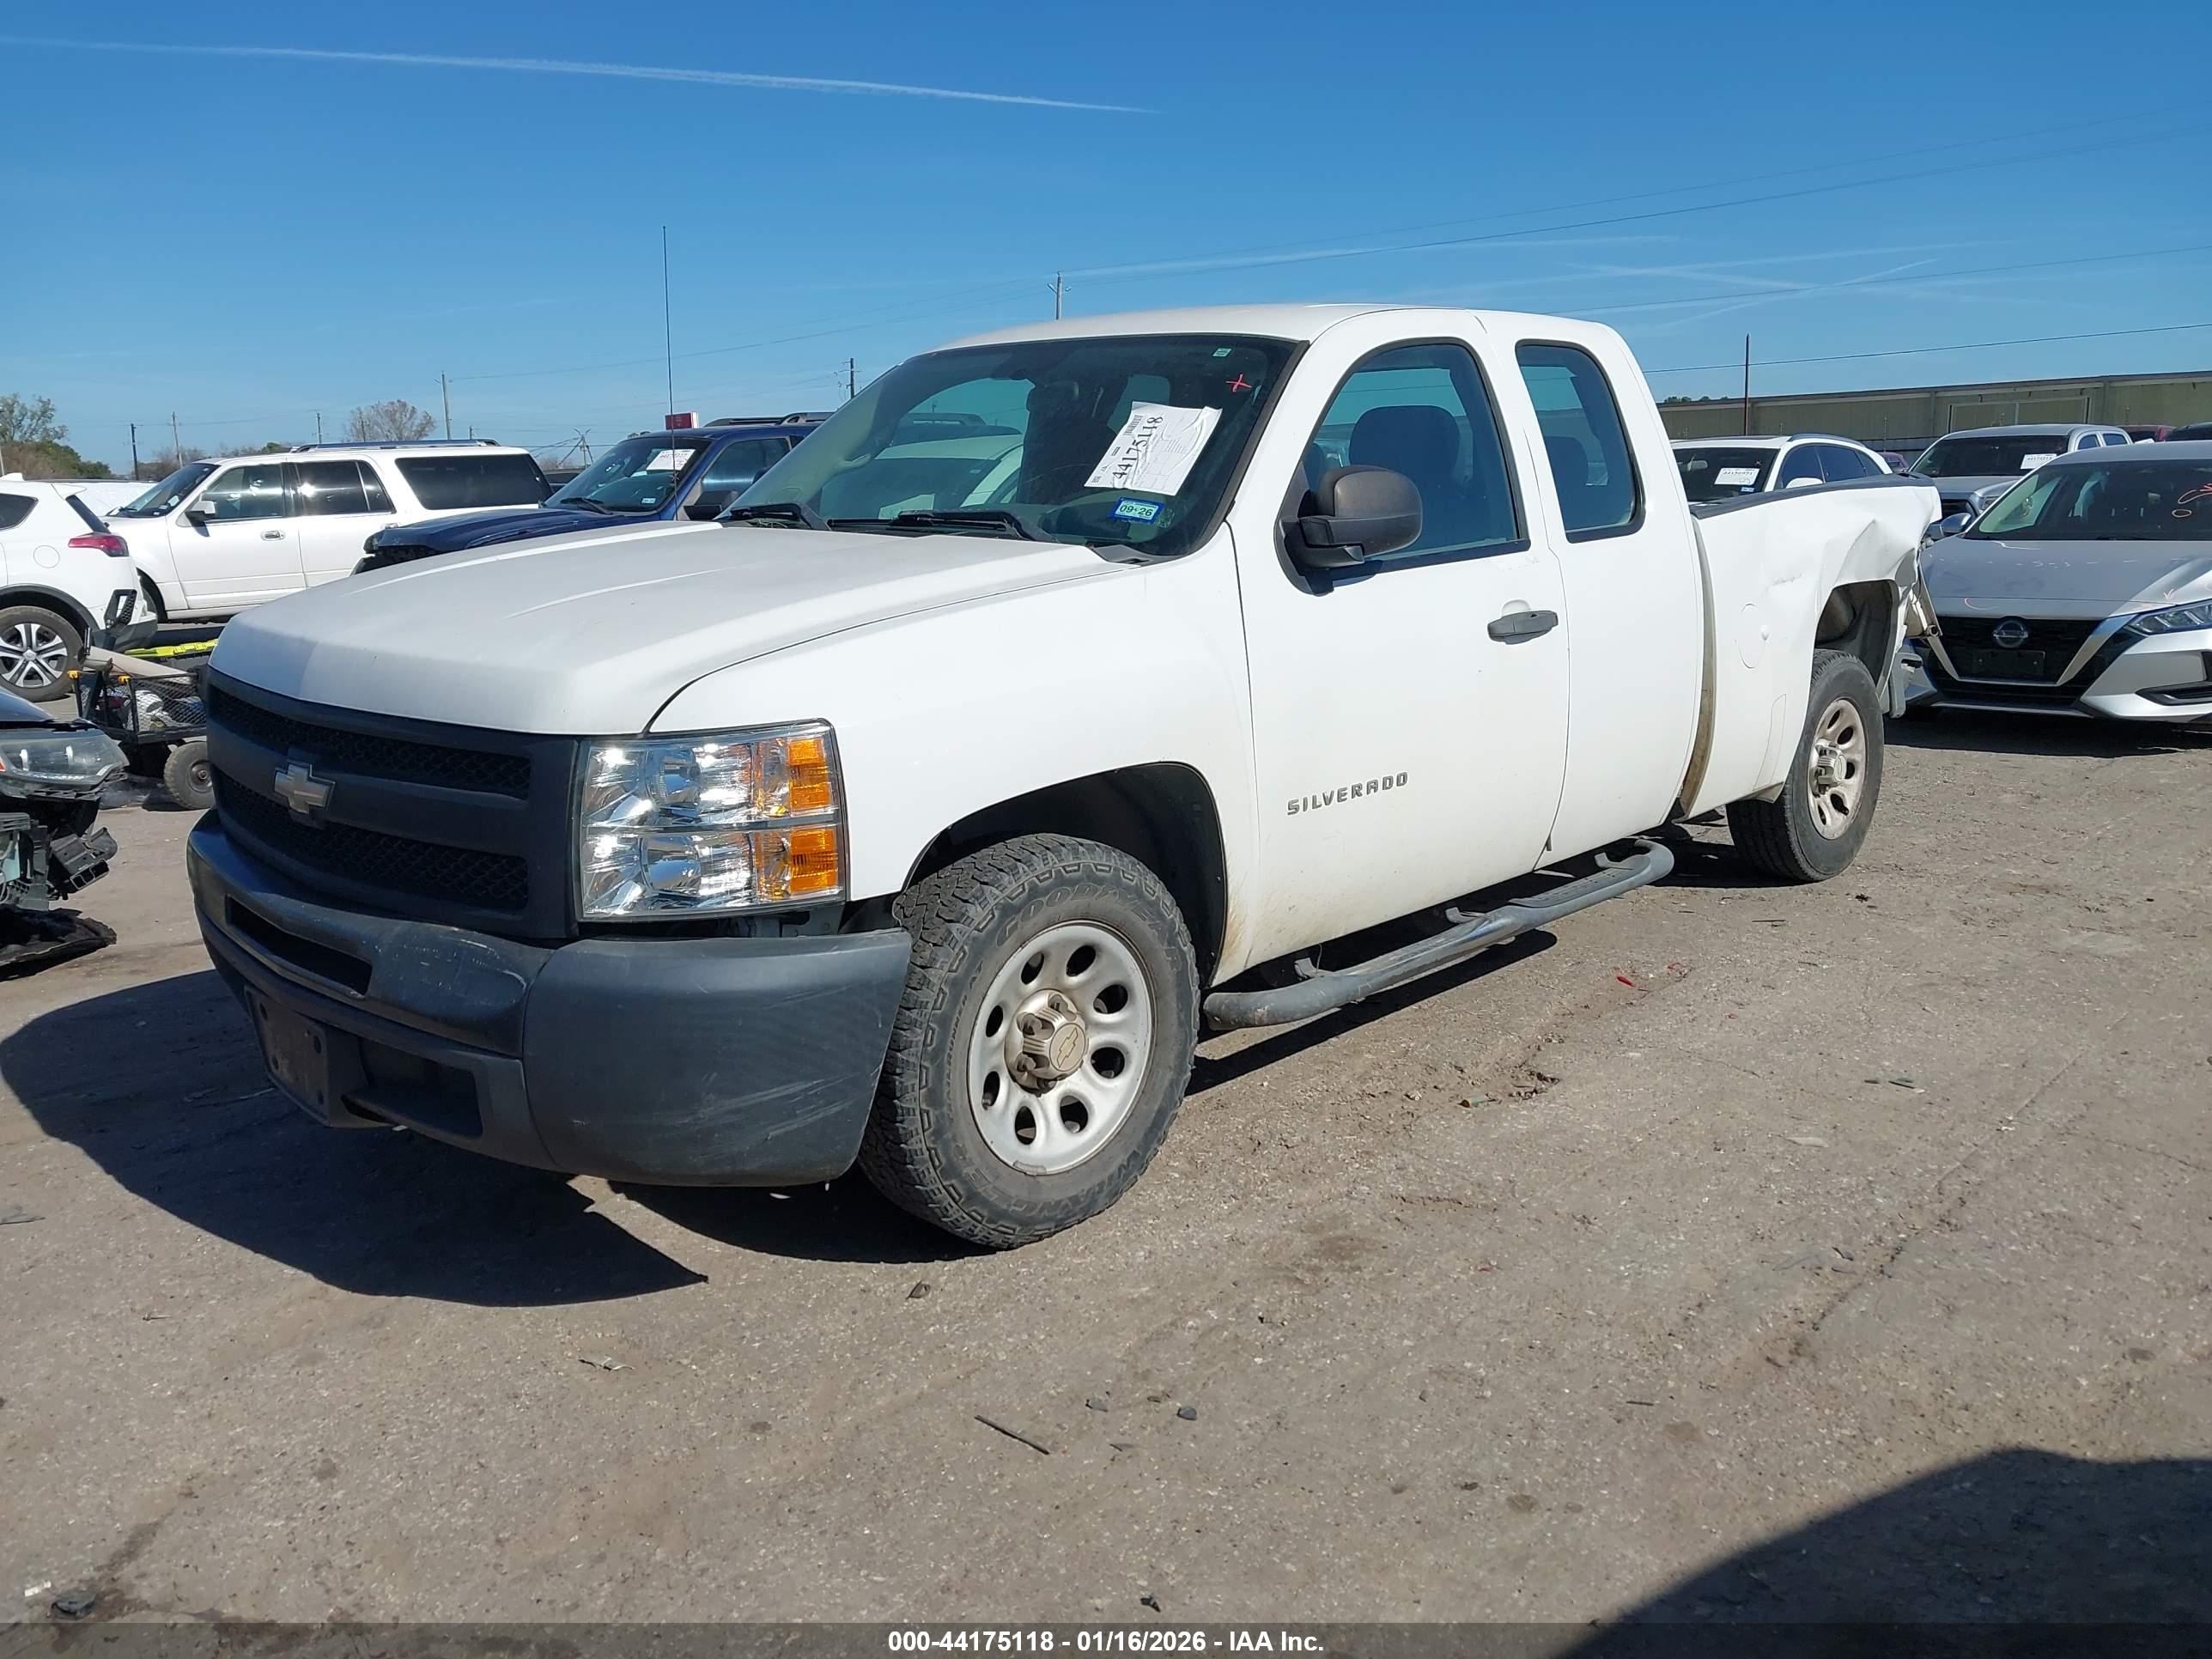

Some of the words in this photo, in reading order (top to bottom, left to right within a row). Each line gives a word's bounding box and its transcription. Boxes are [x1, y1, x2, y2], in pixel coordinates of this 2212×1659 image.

[1112, 416, 1164, 479] 44175118
[1119, 504, 1134, 514] 09
[1137, 507, 1154, 516] 26
[1287, 771, 1408, 816] SILVERADO
